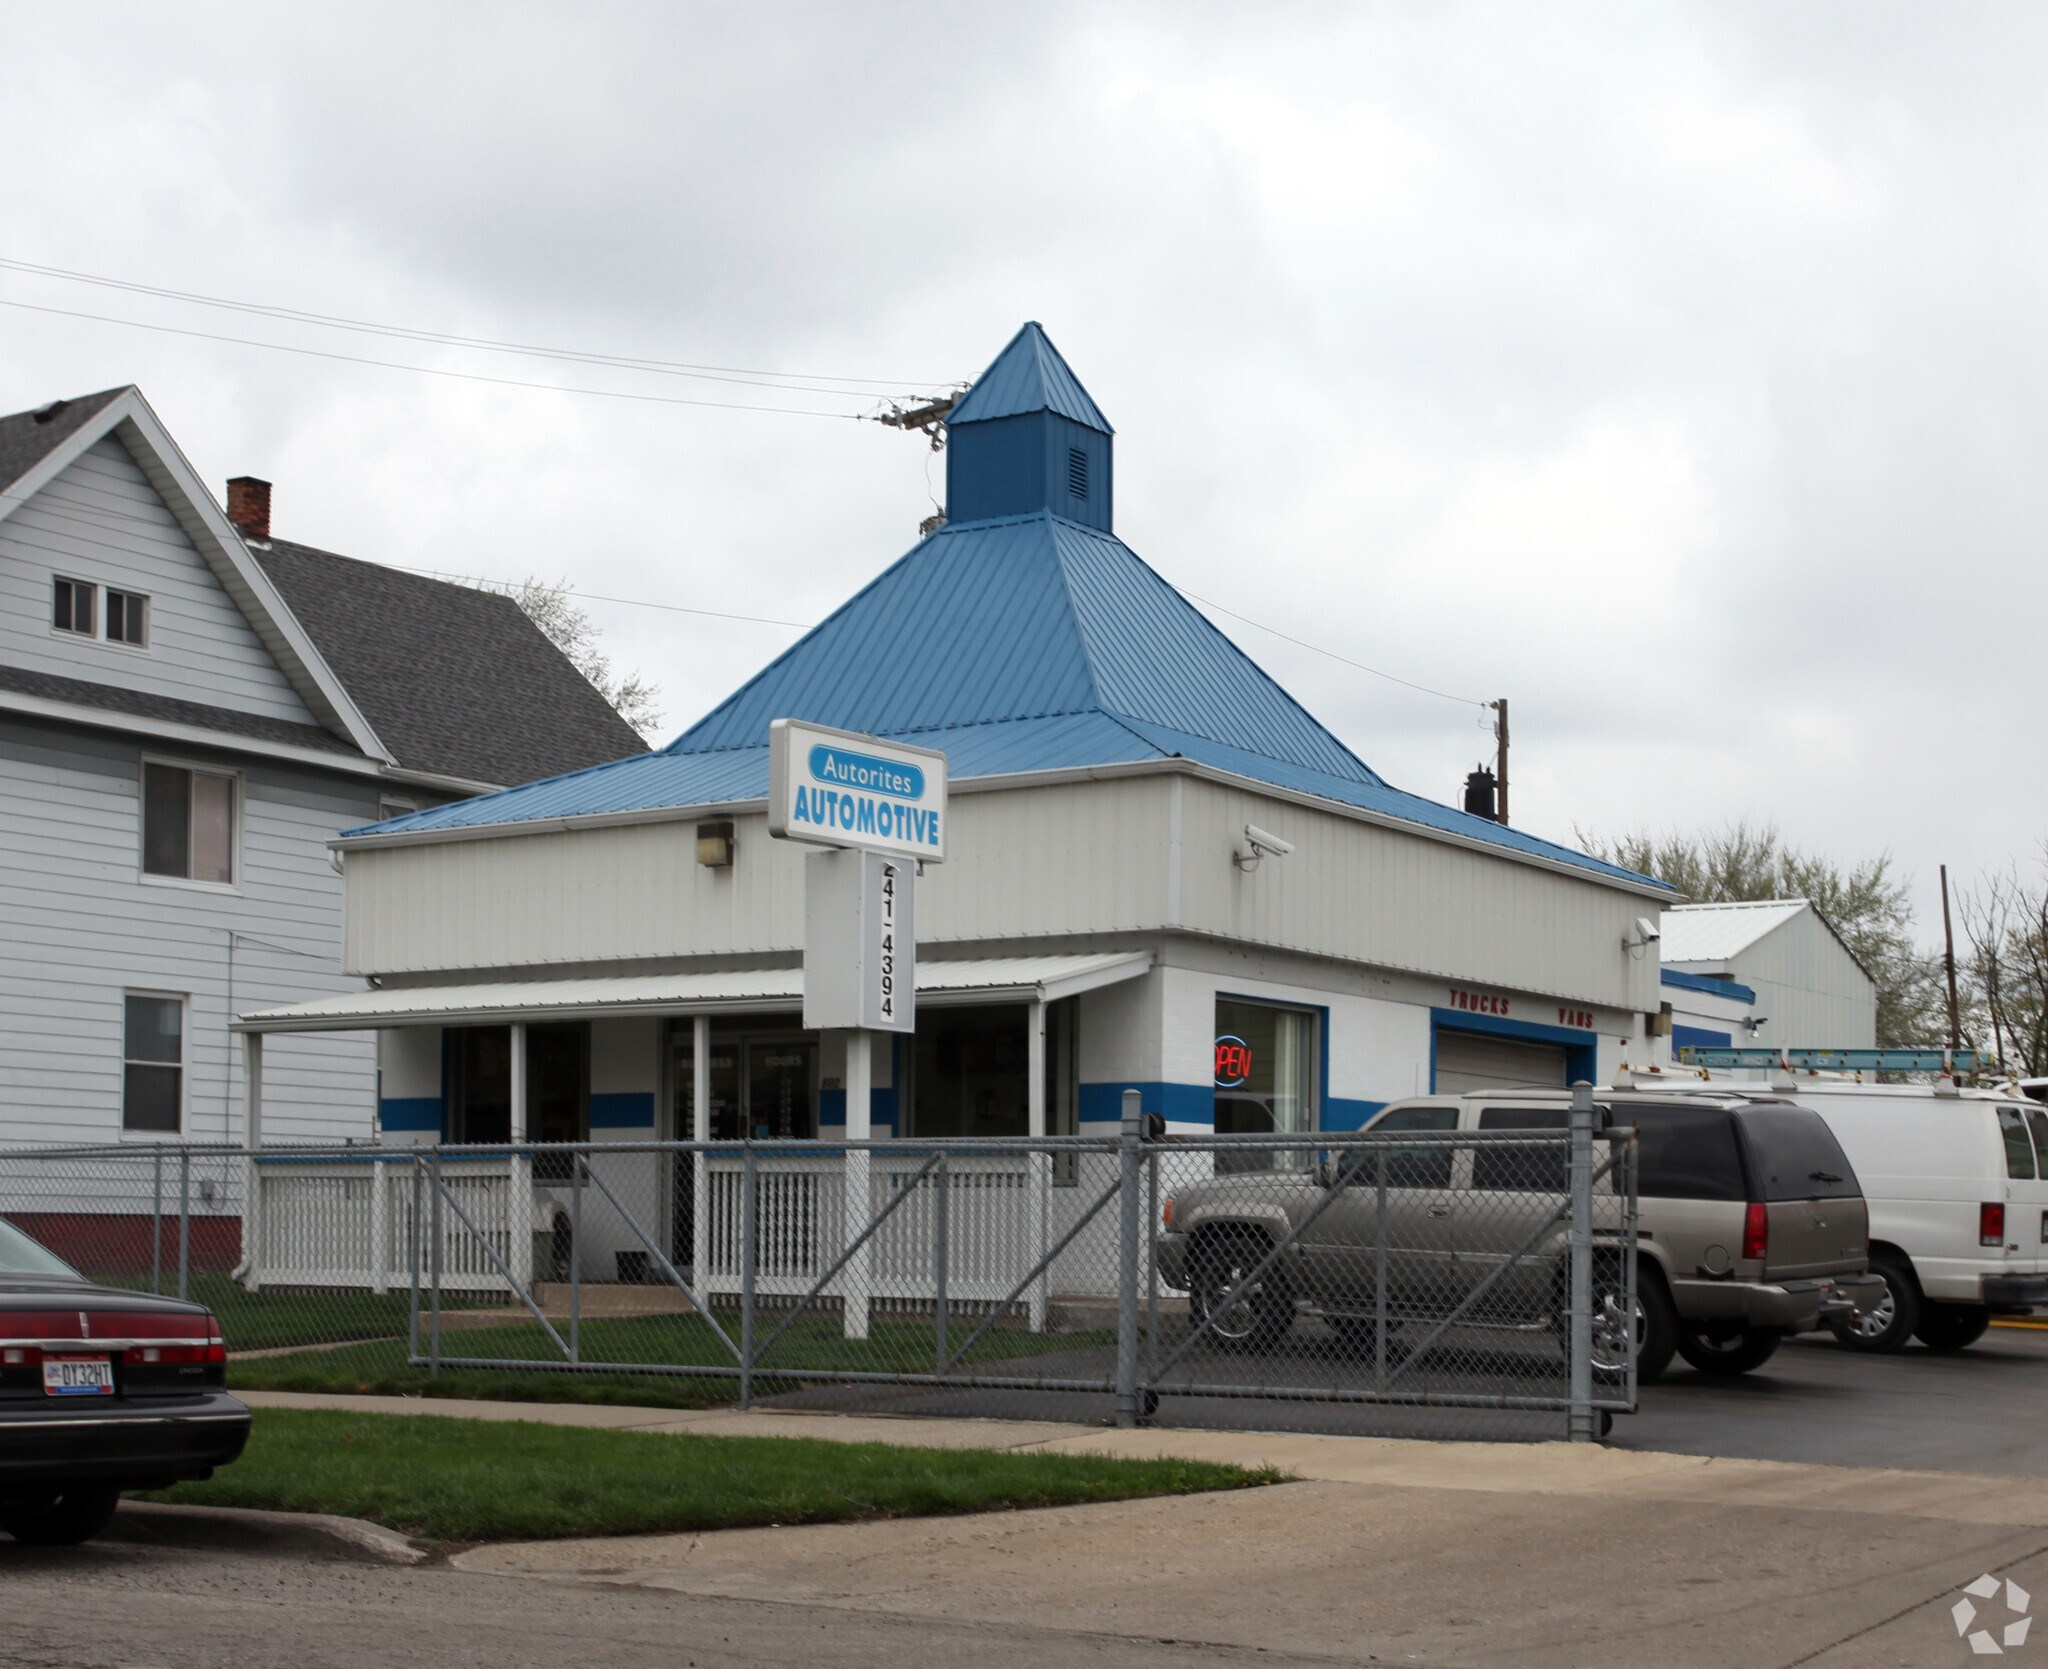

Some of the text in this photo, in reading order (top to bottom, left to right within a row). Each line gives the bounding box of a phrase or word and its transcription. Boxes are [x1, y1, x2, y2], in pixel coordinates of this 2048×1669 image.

[823, 752, 912, 794] Autorites
[794, 785, 939, 846] AUTOMOTIVE
[1450, 989, 1595, 1029] TRUCKS VANS
[765, 1055, 802, 1067] HOURS
